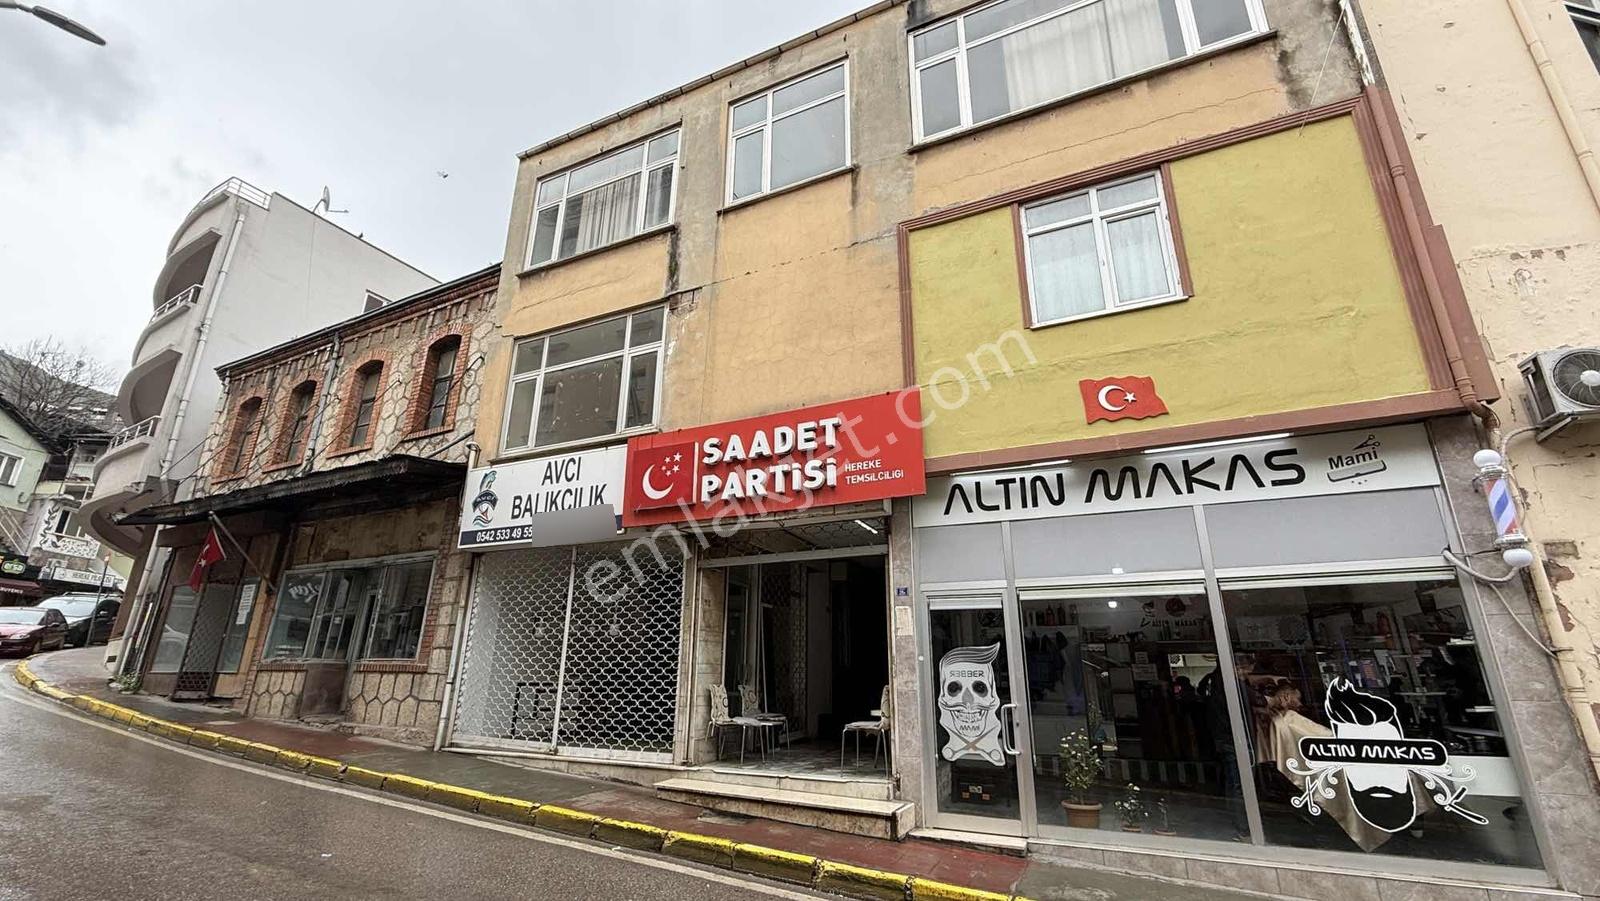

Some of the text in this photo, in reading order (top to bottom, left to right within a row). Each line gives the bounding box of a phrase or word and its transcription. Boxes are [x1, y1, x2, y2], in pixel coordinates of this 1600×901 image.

[702, 417, 842, 465] SAADET
[844, 459, 882, 472] HEREKE
[1328, 447, 1378, 470] Mami
[541, 456, 582, 486] AVCI
[944, 448, 1306, 515] ALTIN MAKAS
[476, 530, 494, 543] 0542
[495, 529, 510, 541] 533
[511, 529, 521, 538] 49
[1308, 743, 1436, 761] ALTIN MAKAS
